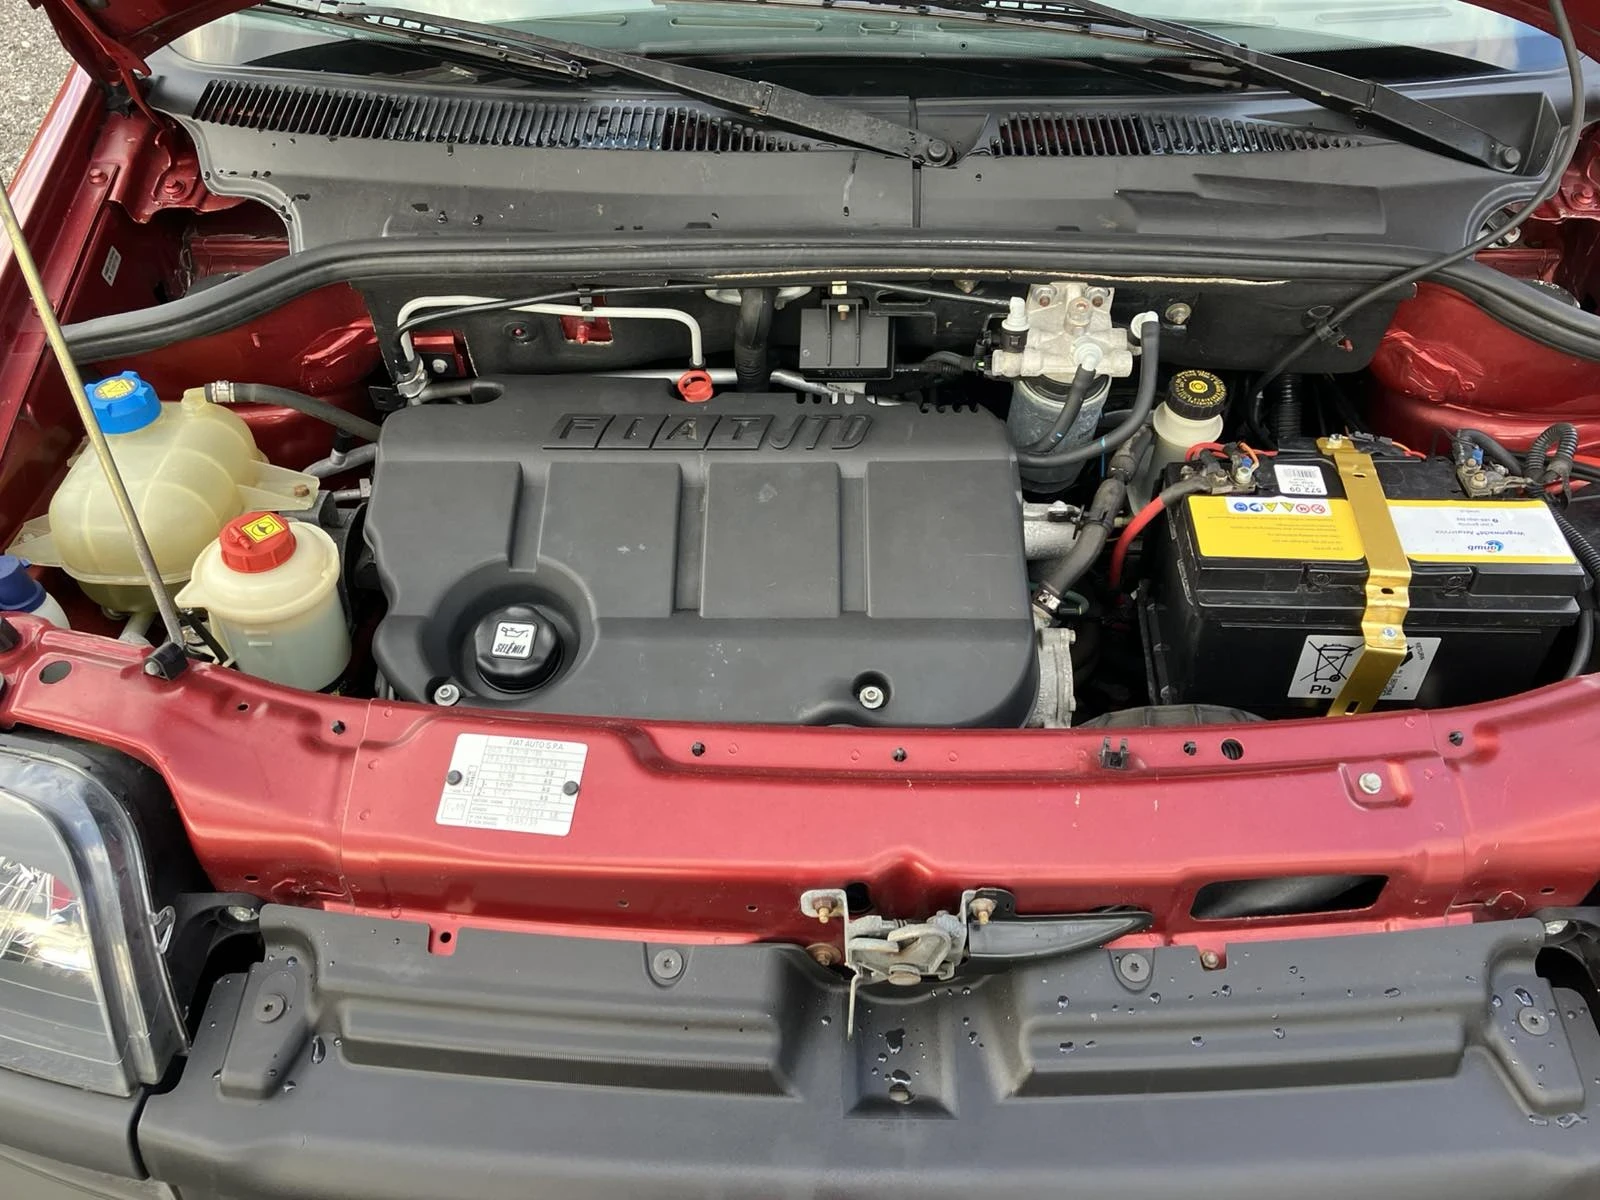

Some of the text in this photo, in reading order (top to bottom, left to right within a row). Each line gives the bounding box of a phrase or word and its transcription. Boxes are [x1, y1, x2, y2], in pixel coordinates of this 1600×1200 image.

[552, 413, 873, 450] FIAT JTD
[494, 641, 526, 655] SELENIA
[1309, 684, 1332, 695] Pb
[525, 740, 545, 748] AUTO
